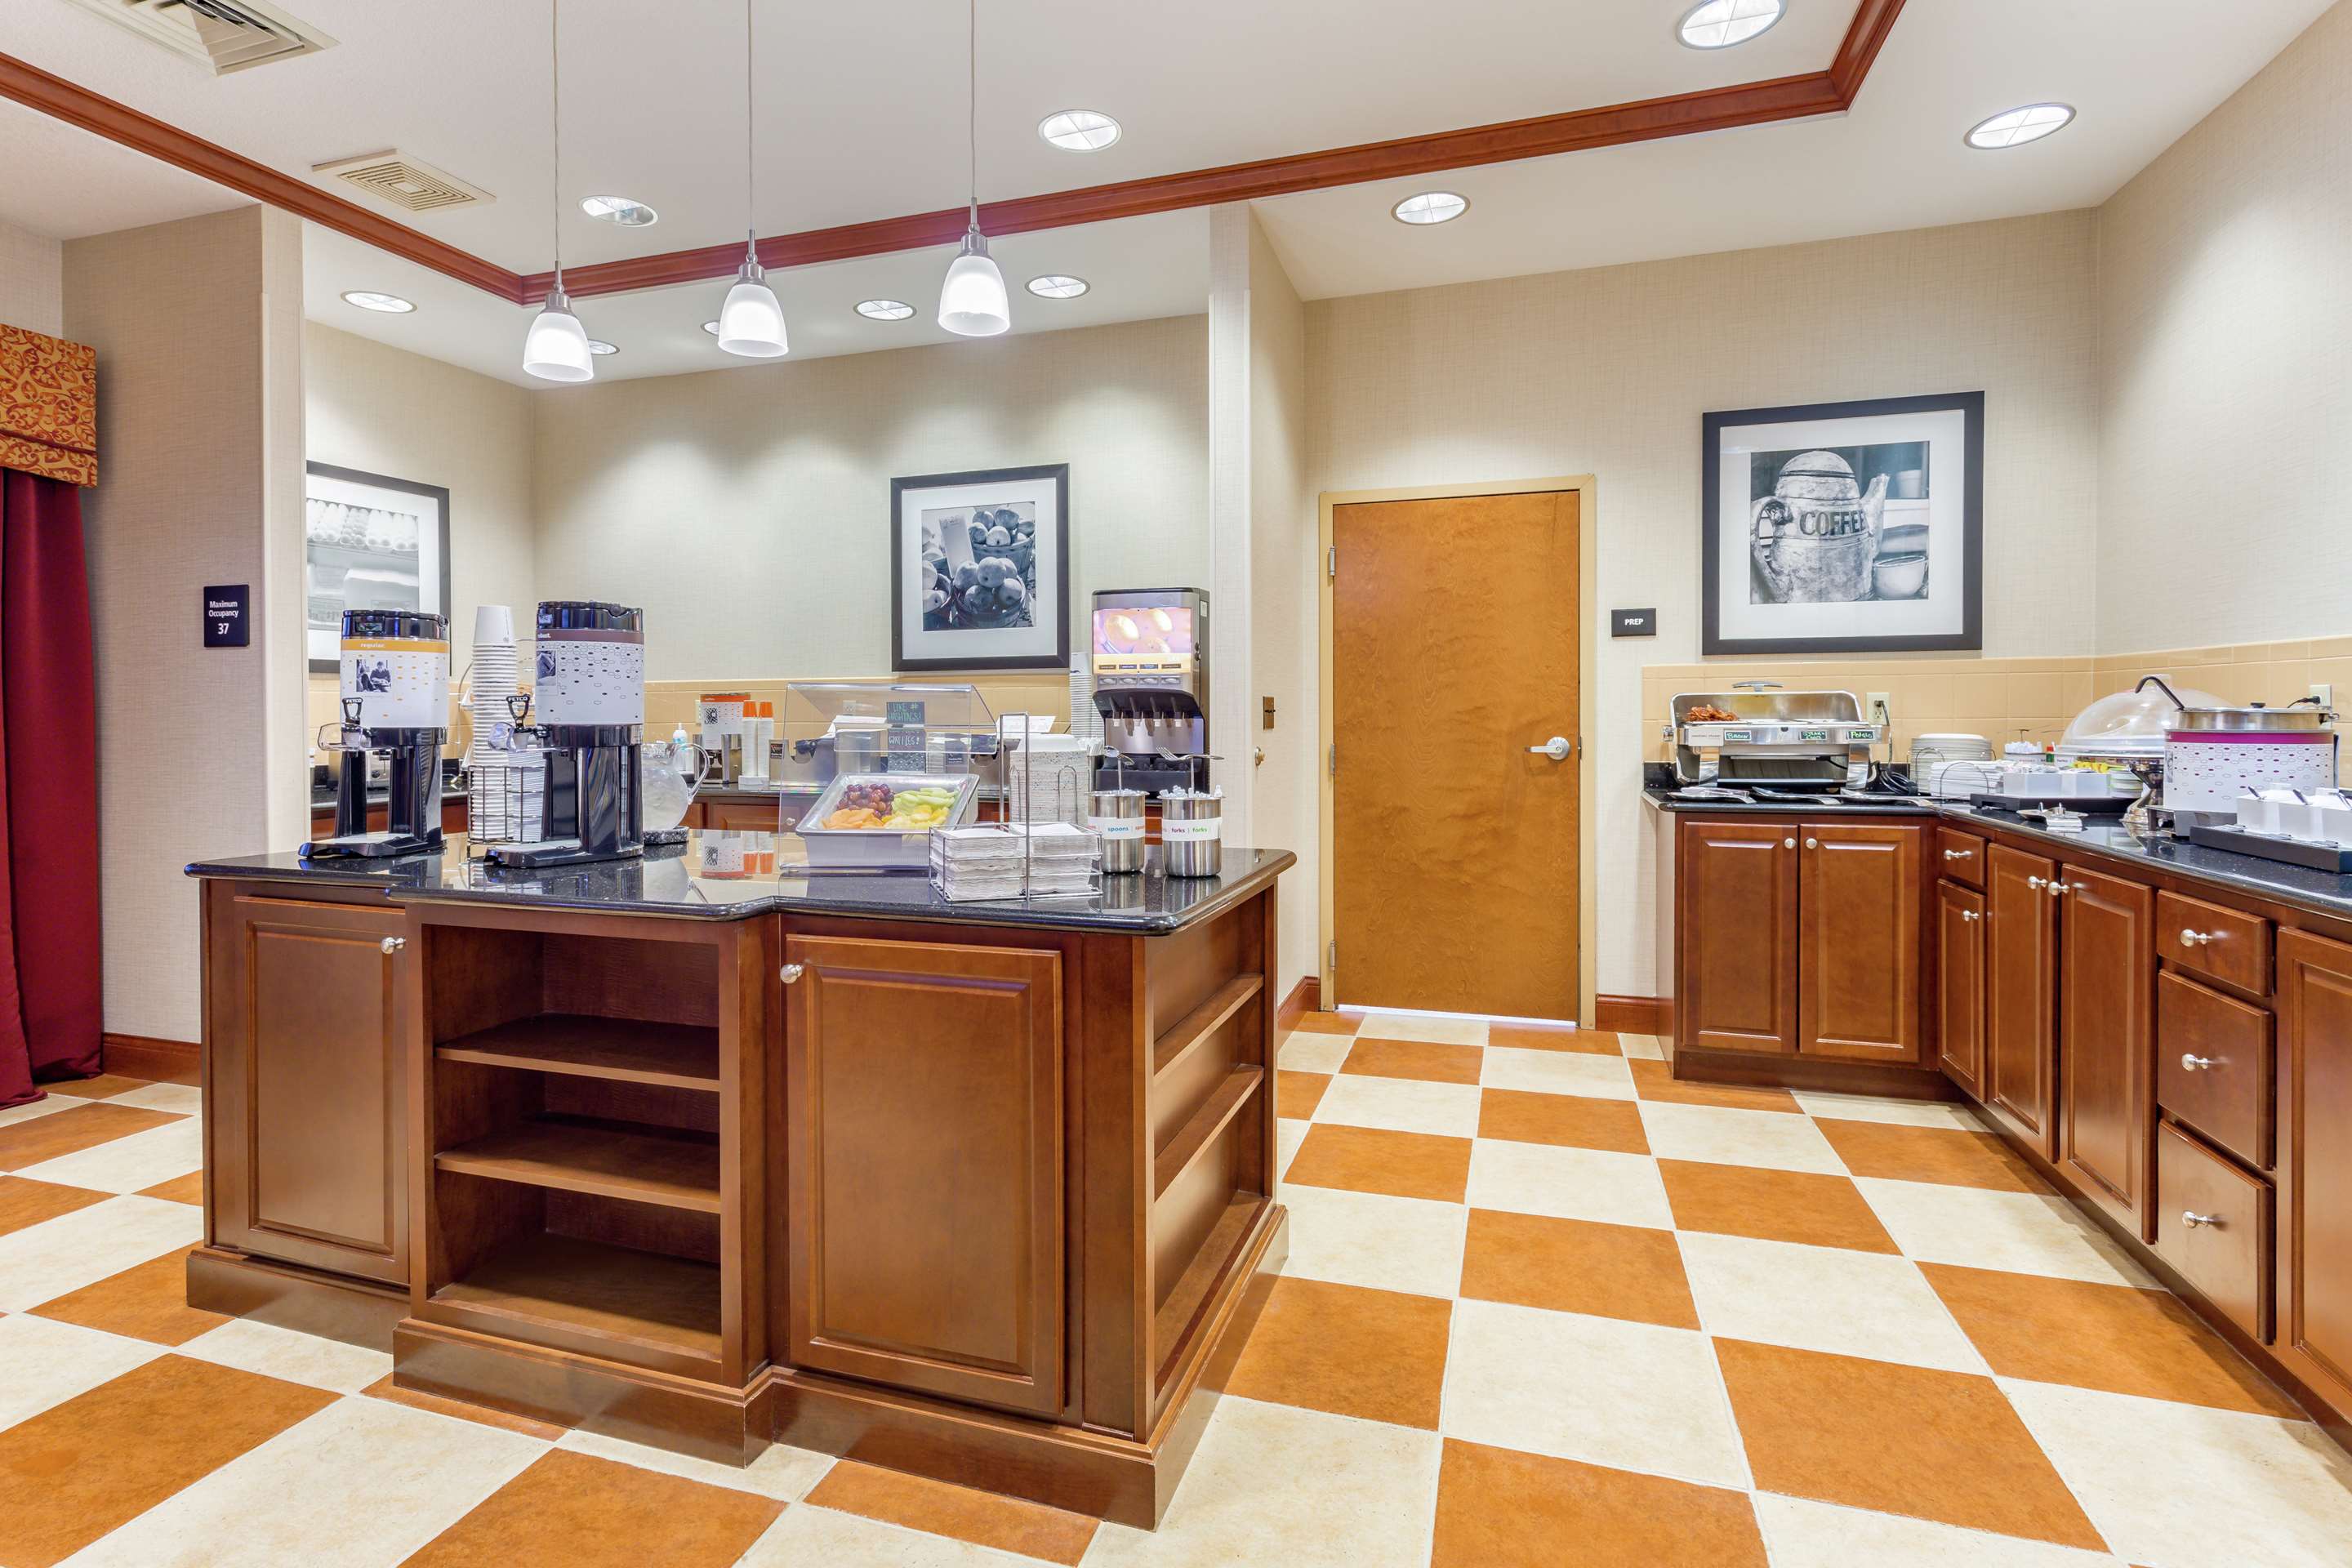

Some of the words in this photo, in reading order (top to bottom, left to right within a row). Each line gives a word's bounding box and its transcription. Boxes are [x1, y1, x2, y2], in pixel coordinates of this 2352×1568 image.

[1799, 510, 1866, 536] COFFEE
[209, 599, 238, 608] Maximum
[208, 609, 239, 618] Occupancy
[1624, 617, 1644, 626] PREP
[217, 622, 229, 635] 37
